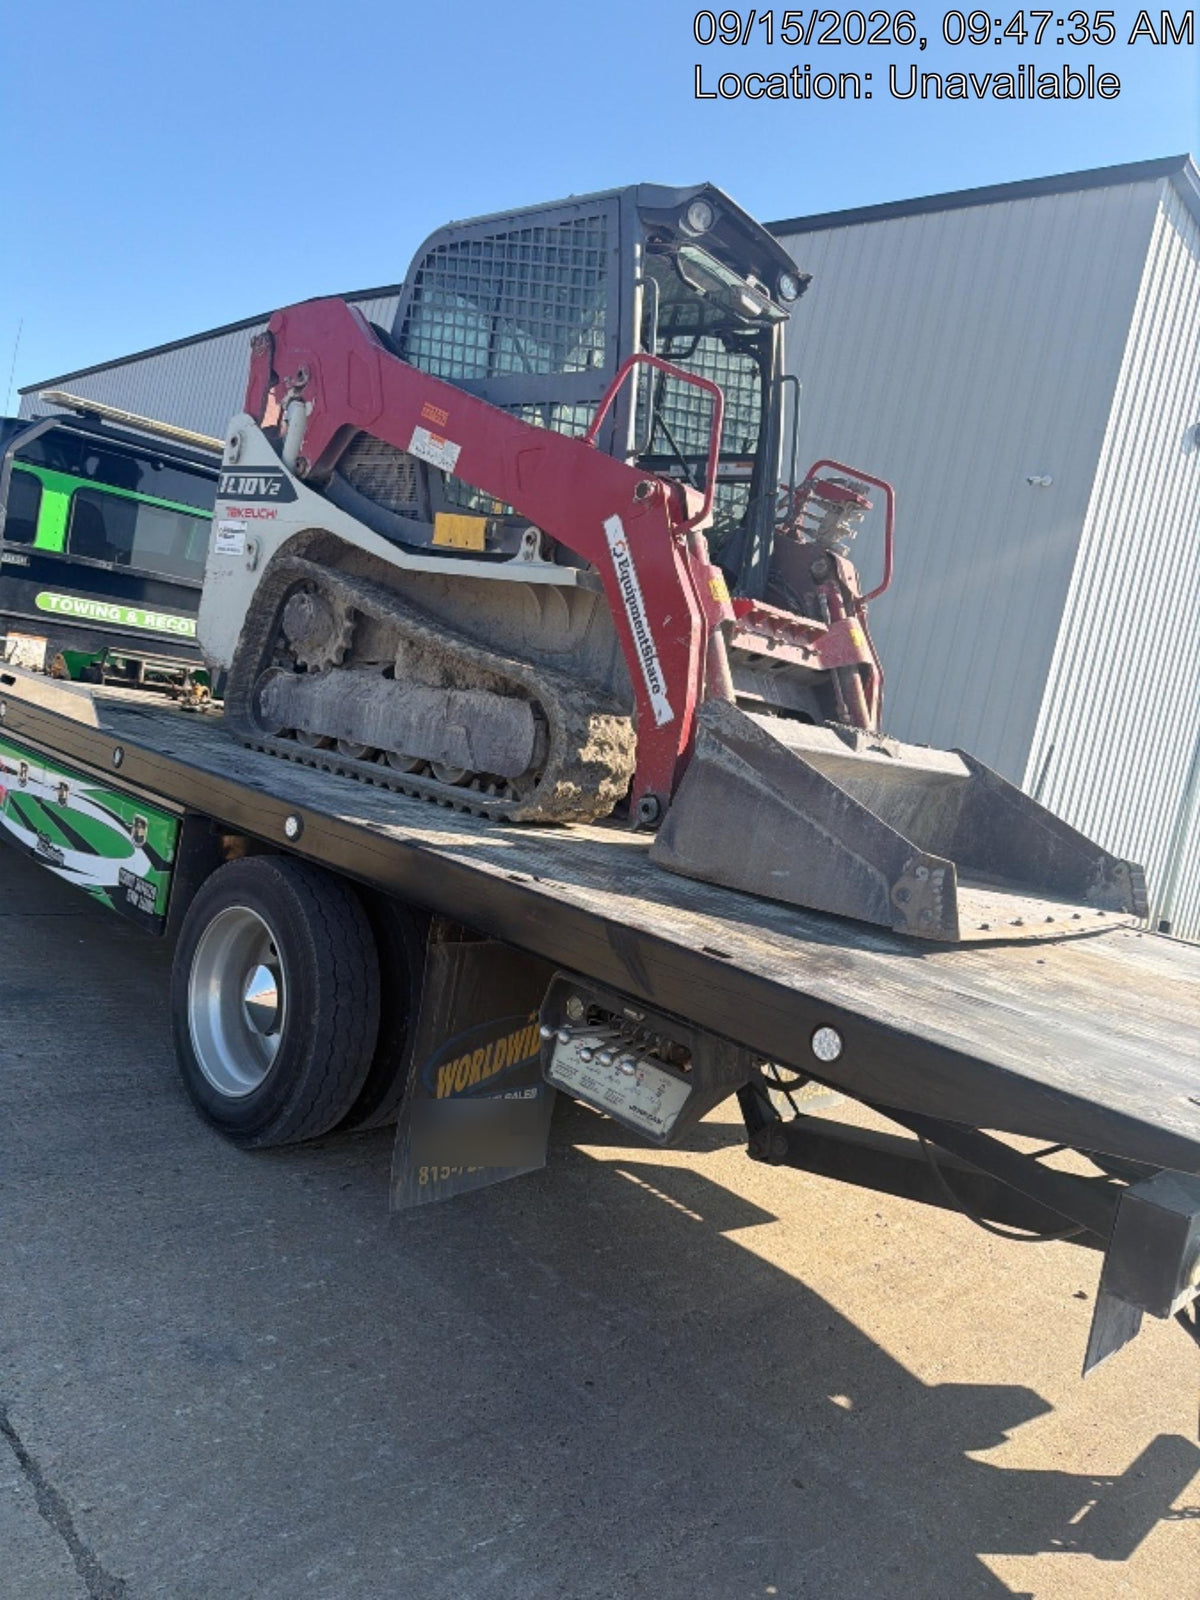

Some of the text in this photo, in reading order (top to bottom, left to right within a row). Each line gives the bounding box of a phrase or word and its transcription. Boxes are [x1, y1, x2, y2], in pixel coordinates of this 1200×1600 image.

[50, 596, 120, 621] TOWING
[126, 611, 139, 625] &
[617, 556, 661, 695] EquipmentShare
